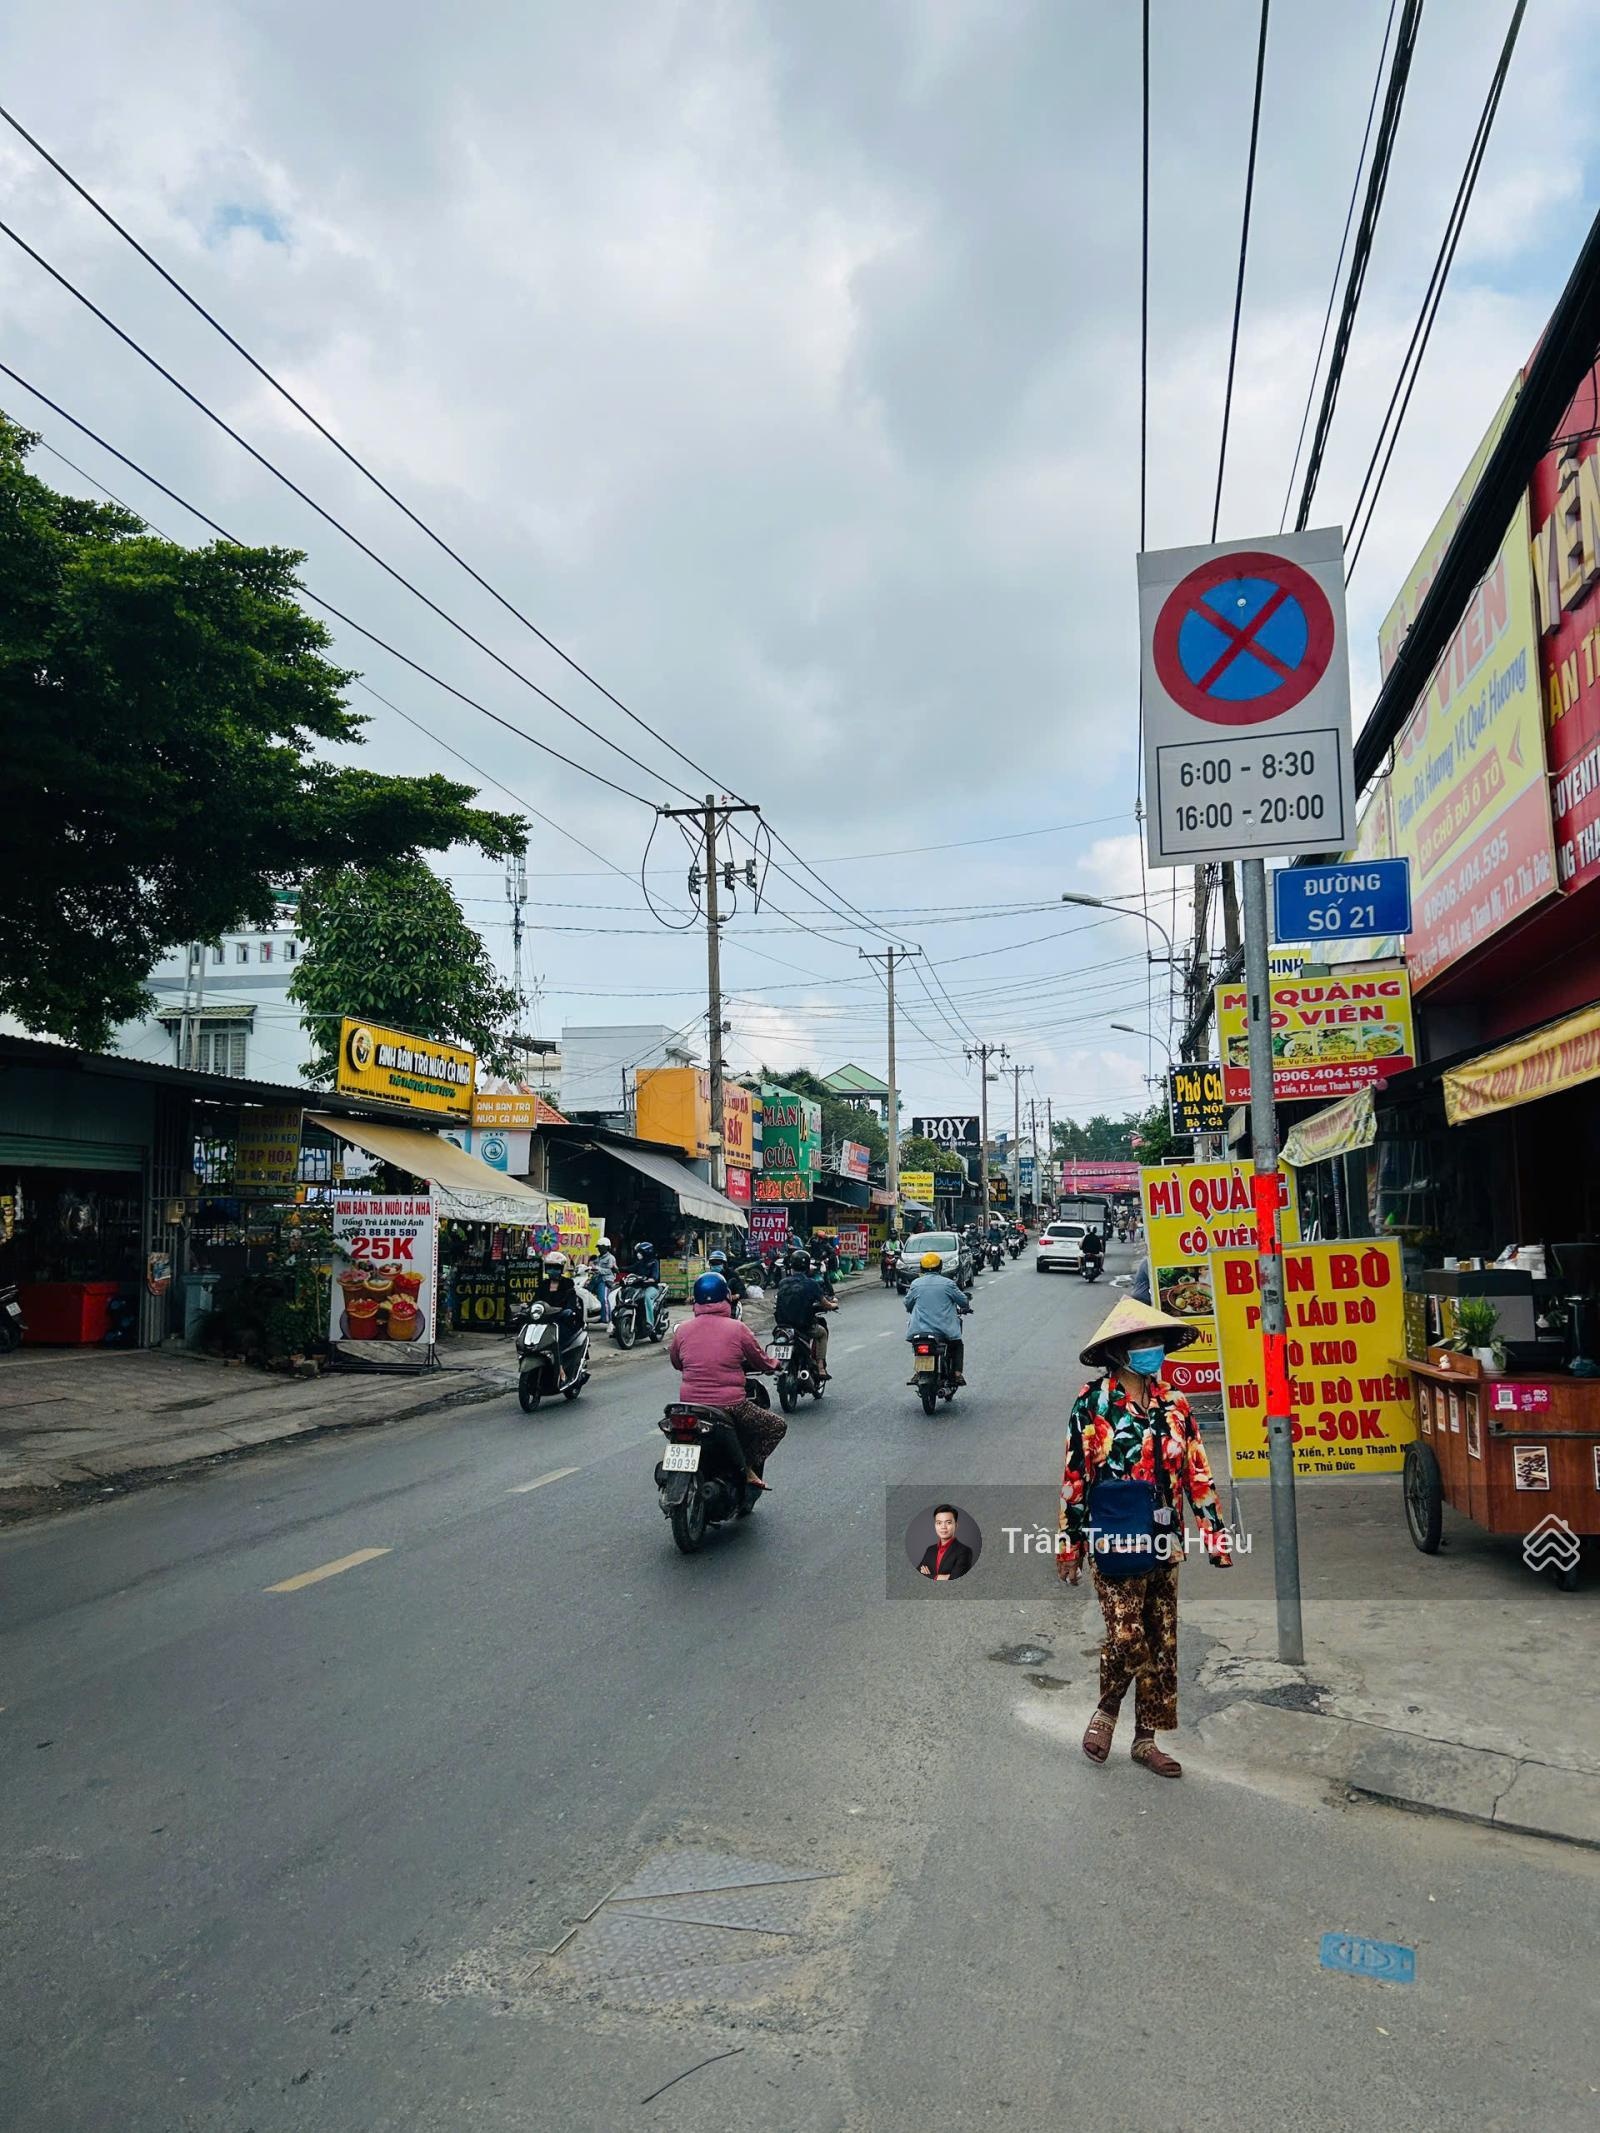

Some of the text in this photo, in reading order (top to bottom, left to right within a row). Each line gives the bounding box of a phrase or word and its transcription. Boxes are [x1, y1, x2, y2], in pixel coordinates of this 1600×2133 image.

[1180, 757, 1231, 787] 6:00
[1262, 750, 1315, 780] 8:30
[1176, 801, 1233, 832] 16:00
[1260, 795, 1324, 825] 20:00
[1303, 872, 1381, 896] ĐƯỜNG
[1308, 898, 1376, 931] SỐ 21
[1268, 958, 1303, 976] HỊNH
[1224, 982, 1400, 1010] M QUẢNG
[1299, 1004, 1385, 1026] VIÊN
[1273, 1066, 1378, 1083] 0906.404.595
[1176, 1072, 1222, 1103] Phở Ch
[477, 1102, 493, 1112] ANH
[1184, 1103, 1223, 1116] HÀ NỘI
[921, 1118, 970, 1140] BOY
[1186, 1118, 1200, 1128] Bò
[1208, 1117, 1223, 1127] Gà
[763, 1138, 798, 1168] CỬA
[1149, 1172, 1183, 1217] MÌ
[336, 1201, 351, 1215] ANH
[342, 1216, 362, 1227] Uống
[369, 1229, 381, 1237] 88
[384, 1229, 396, 1237] 88
[399, 1228, 417, 1237] 580
[351, 1237, 414, 1260] 25K
[1179, 1226, 1209, 1255] CÔ
[1224, 1246, 1391, 1295] BN BÒ
[1297, 1294, 1338, 1327] LẤU
[1345, 1296, 1377, 1325] BÒ
[1199, 1331, 1213, 1347] Vụ
[1310, 1340, 1358, 1366] KHO
[1228, 1379, 1259, 1409] HỦ
[1322, 1374, 1354, 1404] BÒ
[1359, 1374, 1412, 1403] VIÊN
[1262, 1408, 1390, 1444] 5-30K.
[1236, 1450, 1256, 1461] 542
[1328, 1446, 1336, 1456] P.
[1339, 1445, 1364, 1458] Long
[1366, 1443, 1398, 1458] Thạnh
[1298, 1460, 1356, 1473] TP. Thủ Đức
